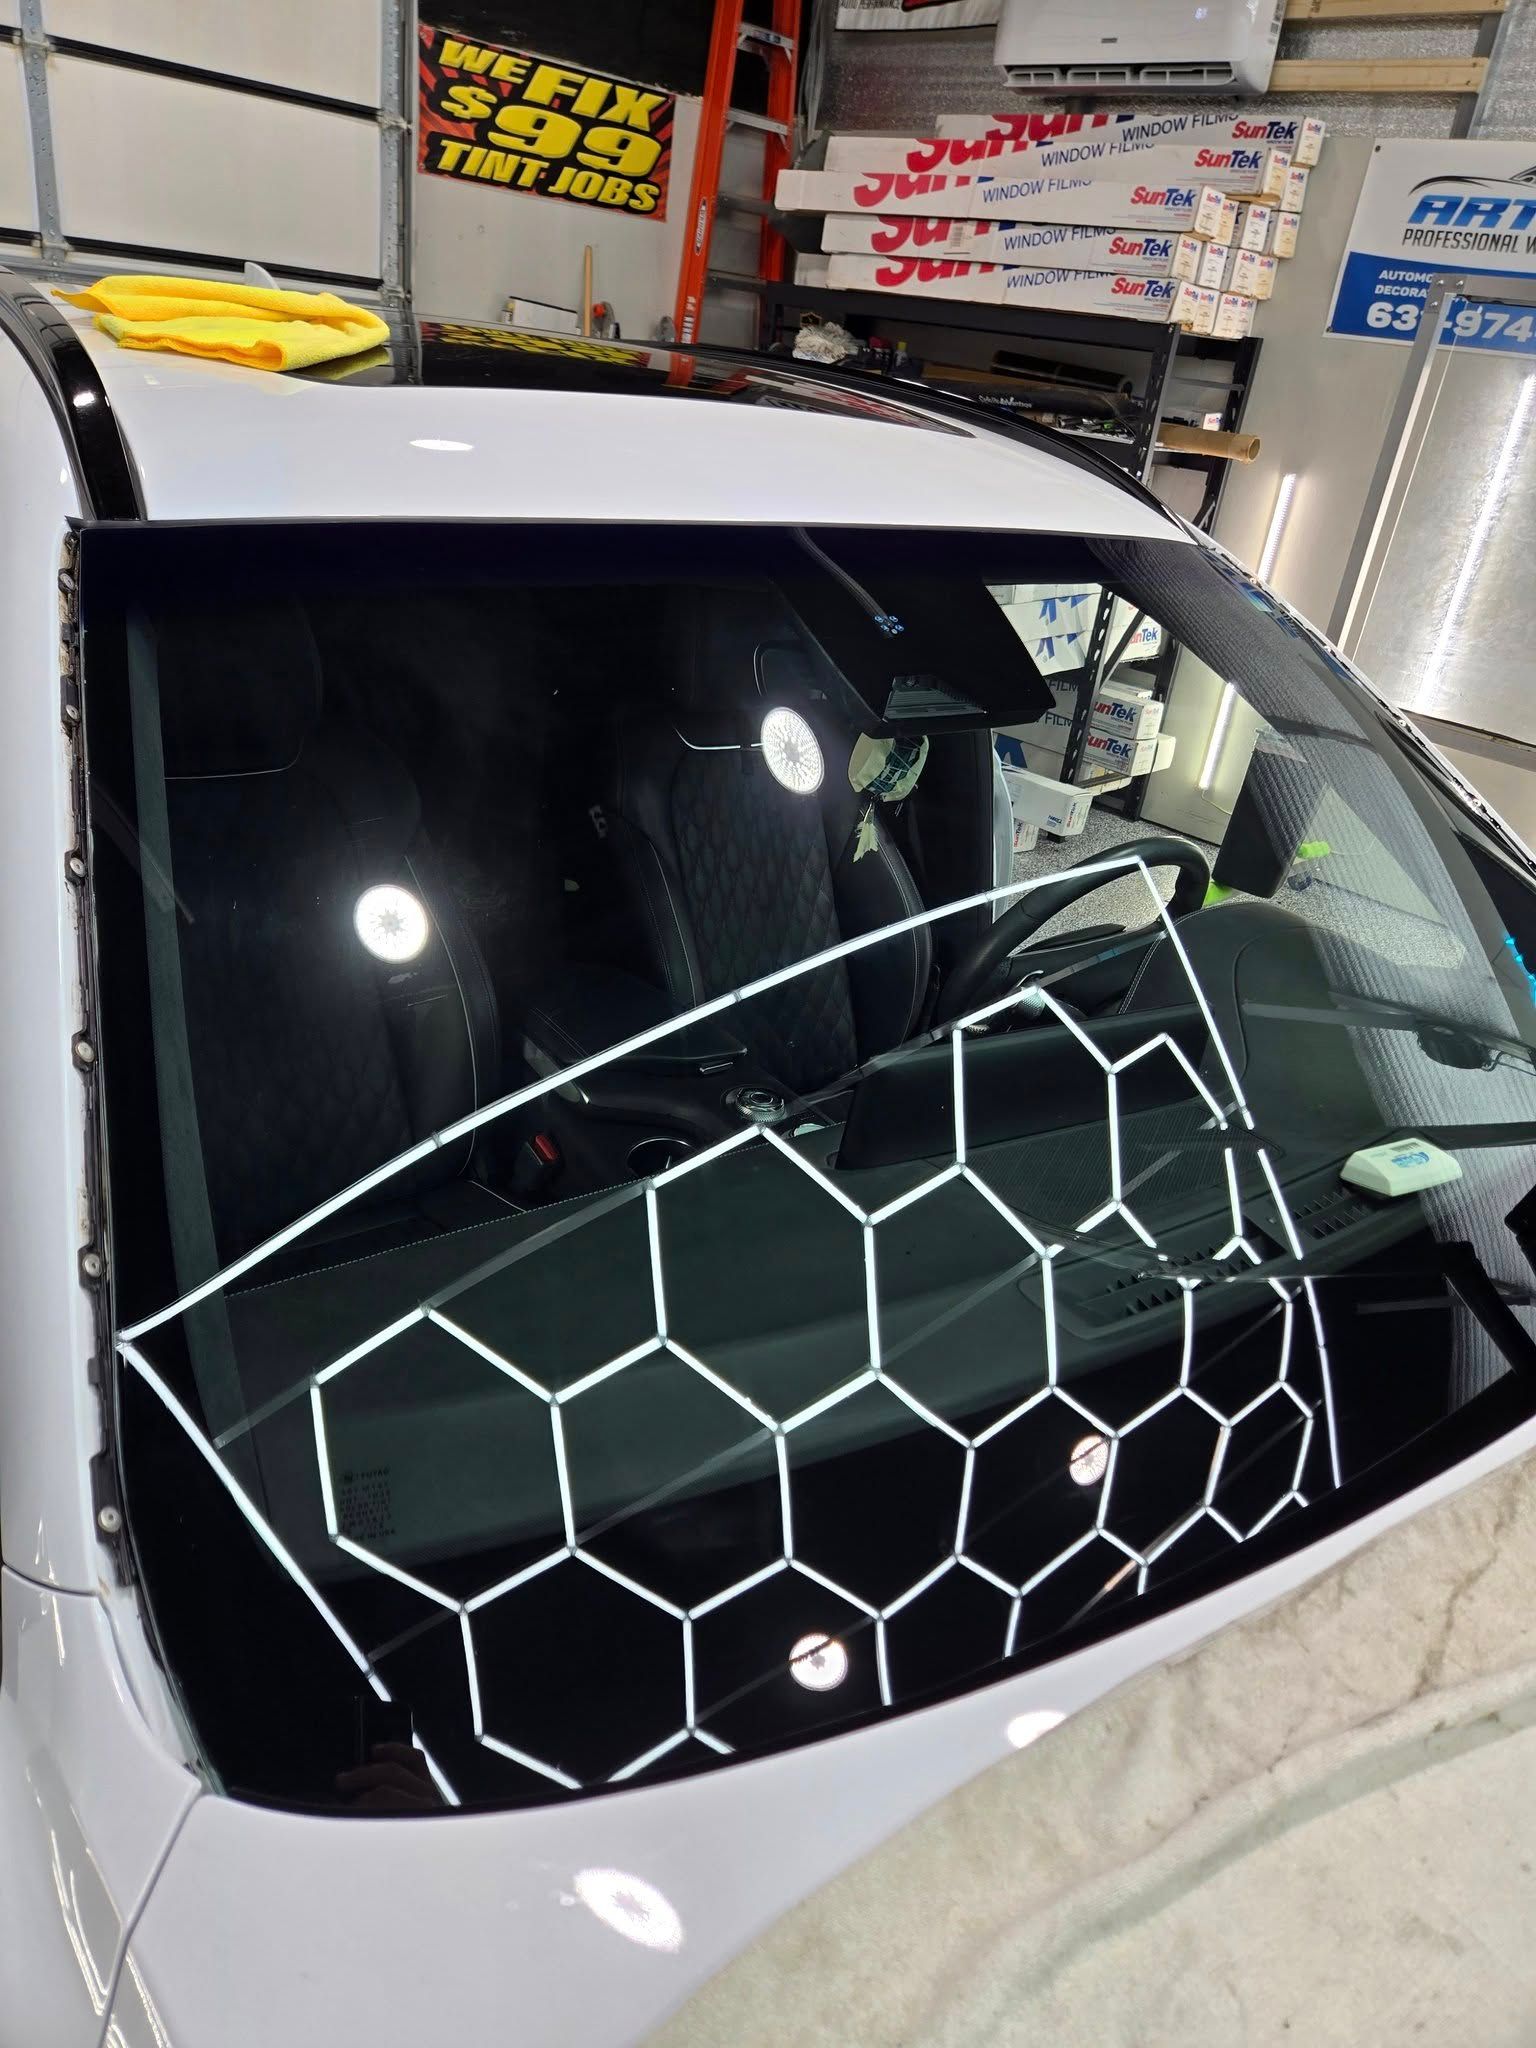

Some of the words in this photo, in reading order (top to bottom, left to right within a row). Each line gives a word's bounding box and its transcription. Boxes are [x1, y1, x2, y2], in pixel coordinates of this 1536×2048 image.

[438, 38, 532, 84] WE
[522, 64, 668, 132] FIX
[440, 85, 662, 177] $99
[1122, 117, 1188, 142] WINDOW
[1231, 120, 1299, 140] SunTek
[1041, 142, 1106, 168] WINDOW
[1193, 148, 1263, 170] SunTek
[437, 139, 549, 188] TINT
[548, 166, 660, 211] JOBS
[982, 179, 1045, 203] WINDOW
[1130, 185, 1197, 207] SunTek
[1004, 228, 1067, 251] WINDOW
[1109, 236, 1173, 258] SunTek
[1401, 228, 1519, 254] PROFESSIONAL
[1006, 268, 1070, 289] WINDOW
[1111, 277, 1176, 299] SunTek
[1374, 284, 1429, 298] DECORA
[1094, 701, 1137, 723] unTek
[1087, 735, 1132, 758] unTek
